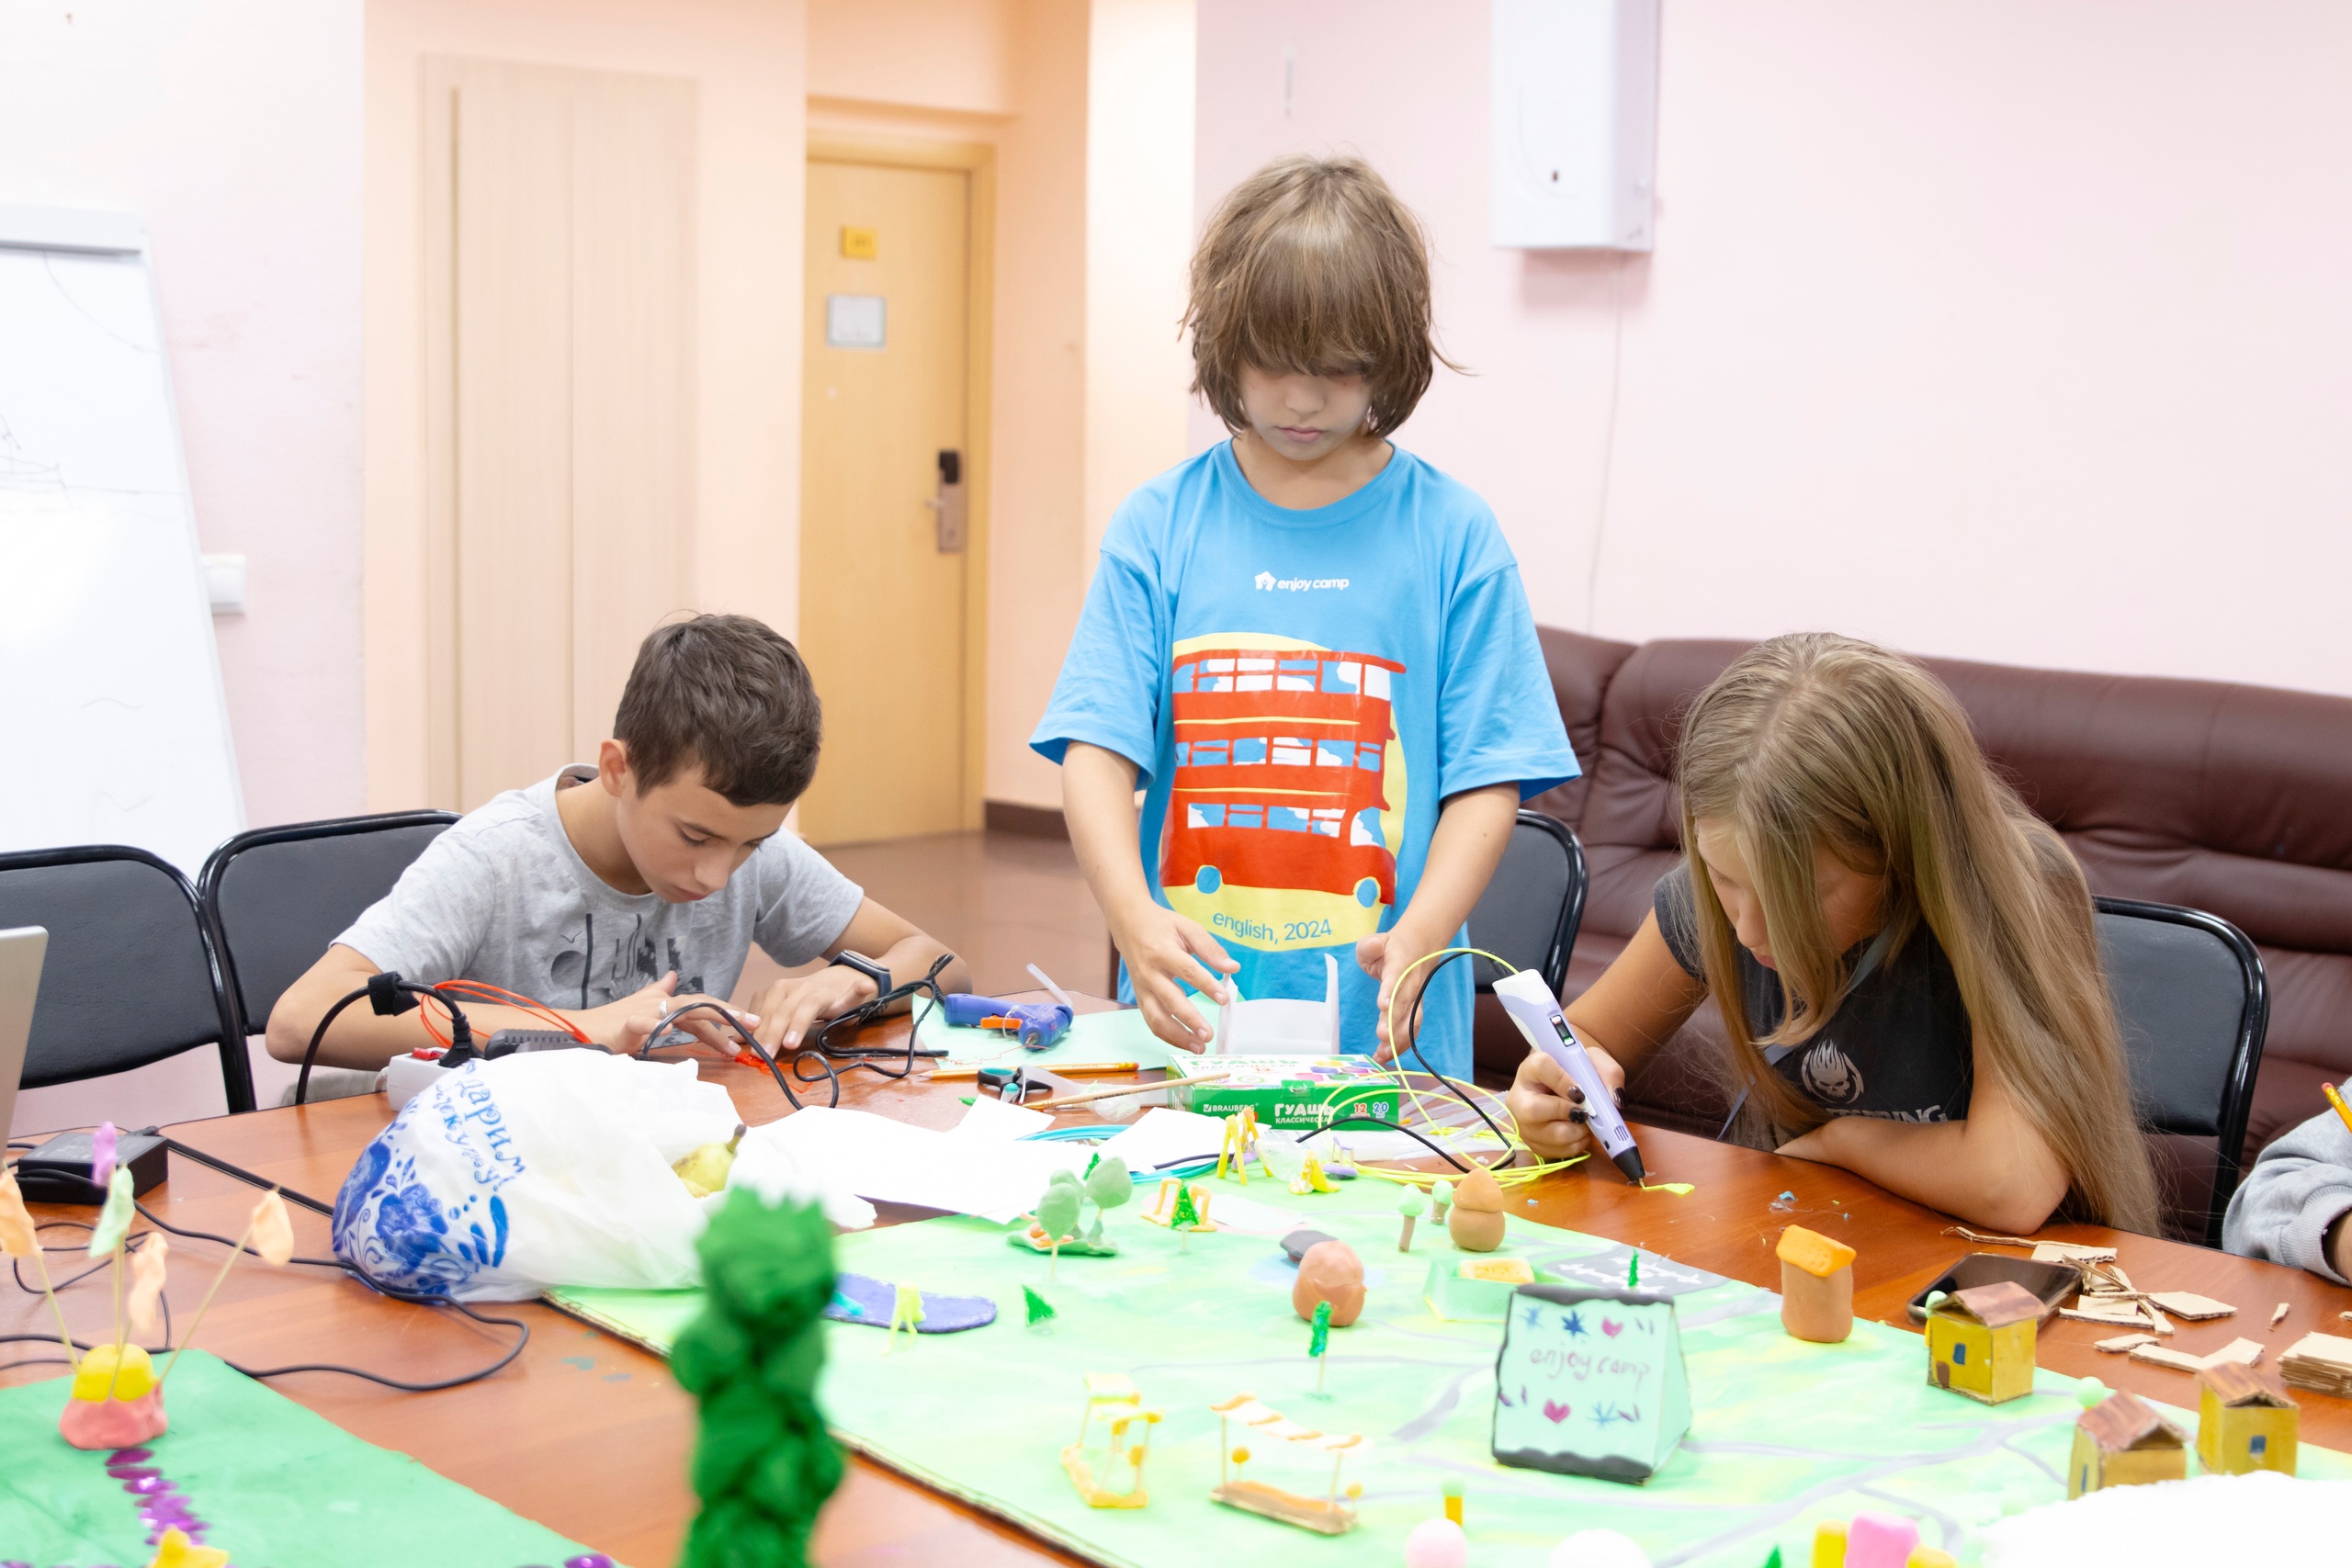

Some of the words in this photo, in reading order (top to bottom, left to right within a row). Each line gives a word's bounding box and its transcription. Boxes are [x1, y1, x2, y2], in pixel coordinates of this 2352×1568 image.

[1277, 577, 1312, 592] enjoy
[1312, 578, 1350, 590] camp
[1212, 912, 1279, 944] english,
[1284, 919, 1332, 941] 2024
[1274, 1102, 1335, 1117] ГУАШЬ
[1353, 1103, 1367, 1113] 12
[1373, 1102, 1389, 1113] 20
[1530, 1341, 1591, 1381] enjoy
[1597, 1355, 1650, 1393] camp
